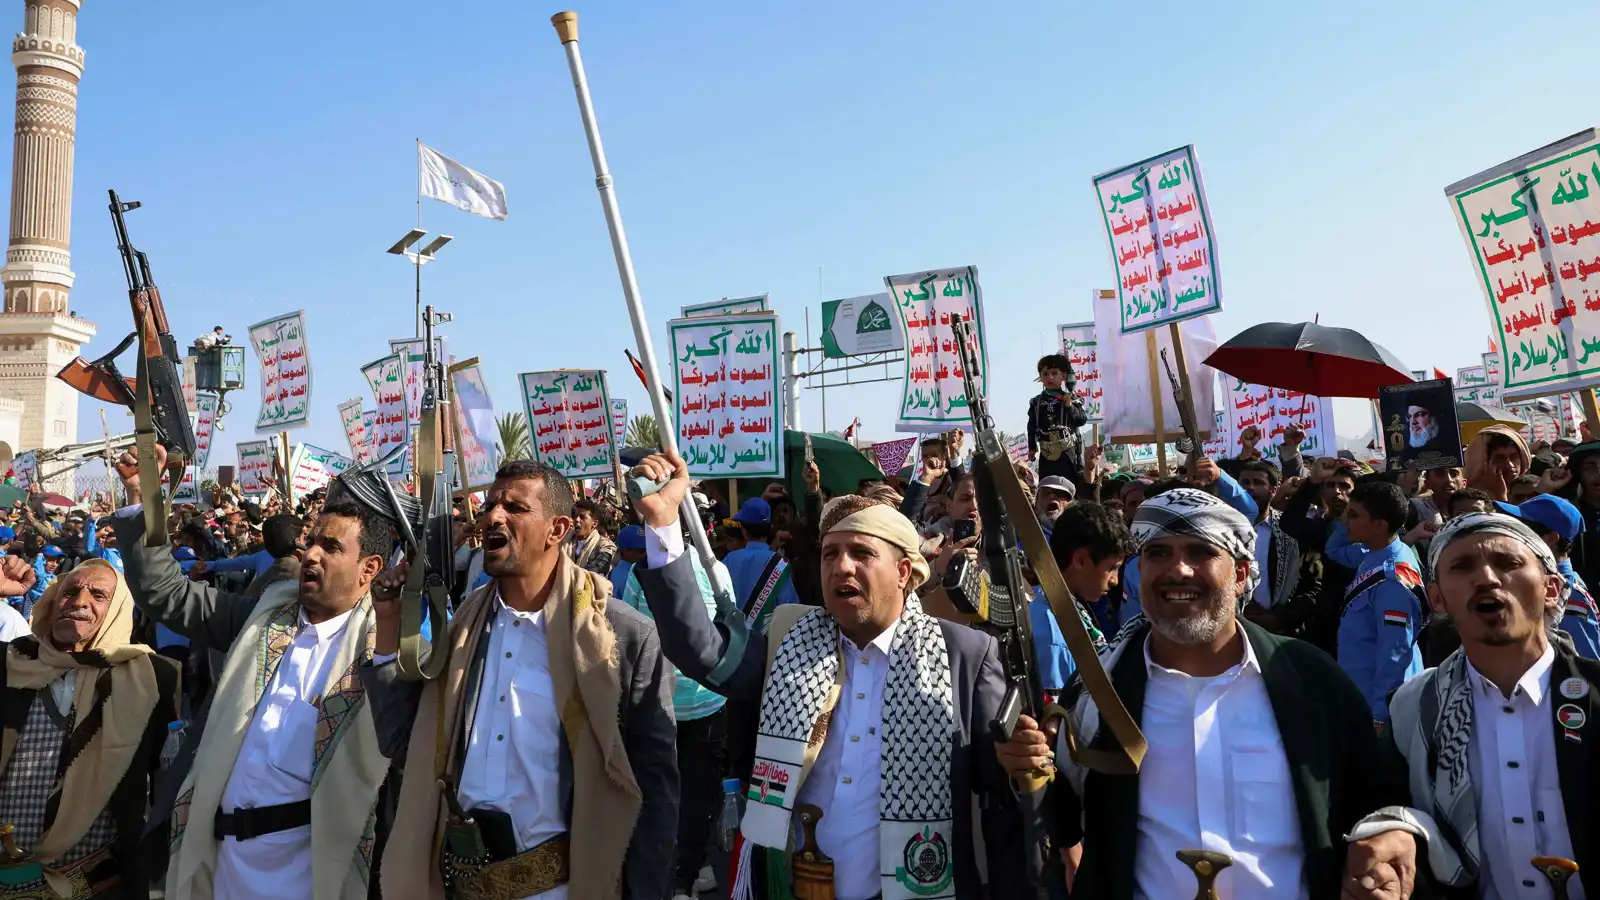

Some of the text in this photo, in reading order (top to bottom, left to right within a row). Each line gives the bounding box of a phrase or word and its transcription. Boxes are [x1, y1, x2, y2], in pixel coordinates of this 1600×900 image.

[1108, 159, 1190, 214] الله أكبر
[1157, 193, 1197, 221] الموت
[1476, 176, 1541, 238] أكبر
[1163, 221, 1204, 249] الموت
[1482, 220, 1600, 266] موت لأمريكا
[1123, 248, 1207, 292] اللعنة على اليهود
[902, 272, 972, 310] الله أكبر
[1172, 275, 1211, 311] النصر
[1504, 301, 1547, 336] اليهود
[260, 321, 287, 353] أكبر
[679, 327, 771, 366] الله أكبر
[281, 346, 304, 361] الموت
[1512, 329, 1569, 379] للإسلام
[281, 365, 307, 381] الموت
[681, 361, 771, 387] الموت لأمريكا
[910, 363, 932, 384] اليهود
[934, 362, 949, 383] على
[530, 374, 601, 400] الله أكبر
[730, 389, 772, 411] الموت
[284, 401, 306, 420] النصر
[571, 396, 603, 413] الموت
[575, 415, 606, 431] الموت
[681, 416, 772, 441] اللعنة على اليهود
[539, 432, 609, 454] اللعنة على اليهود
[729, 438, 772, 470] النصر
[303, 452, 334, 464] أكبر
[581, 449, 612, 472] النصر
[749, 567, 782, 620] PALESTINE
